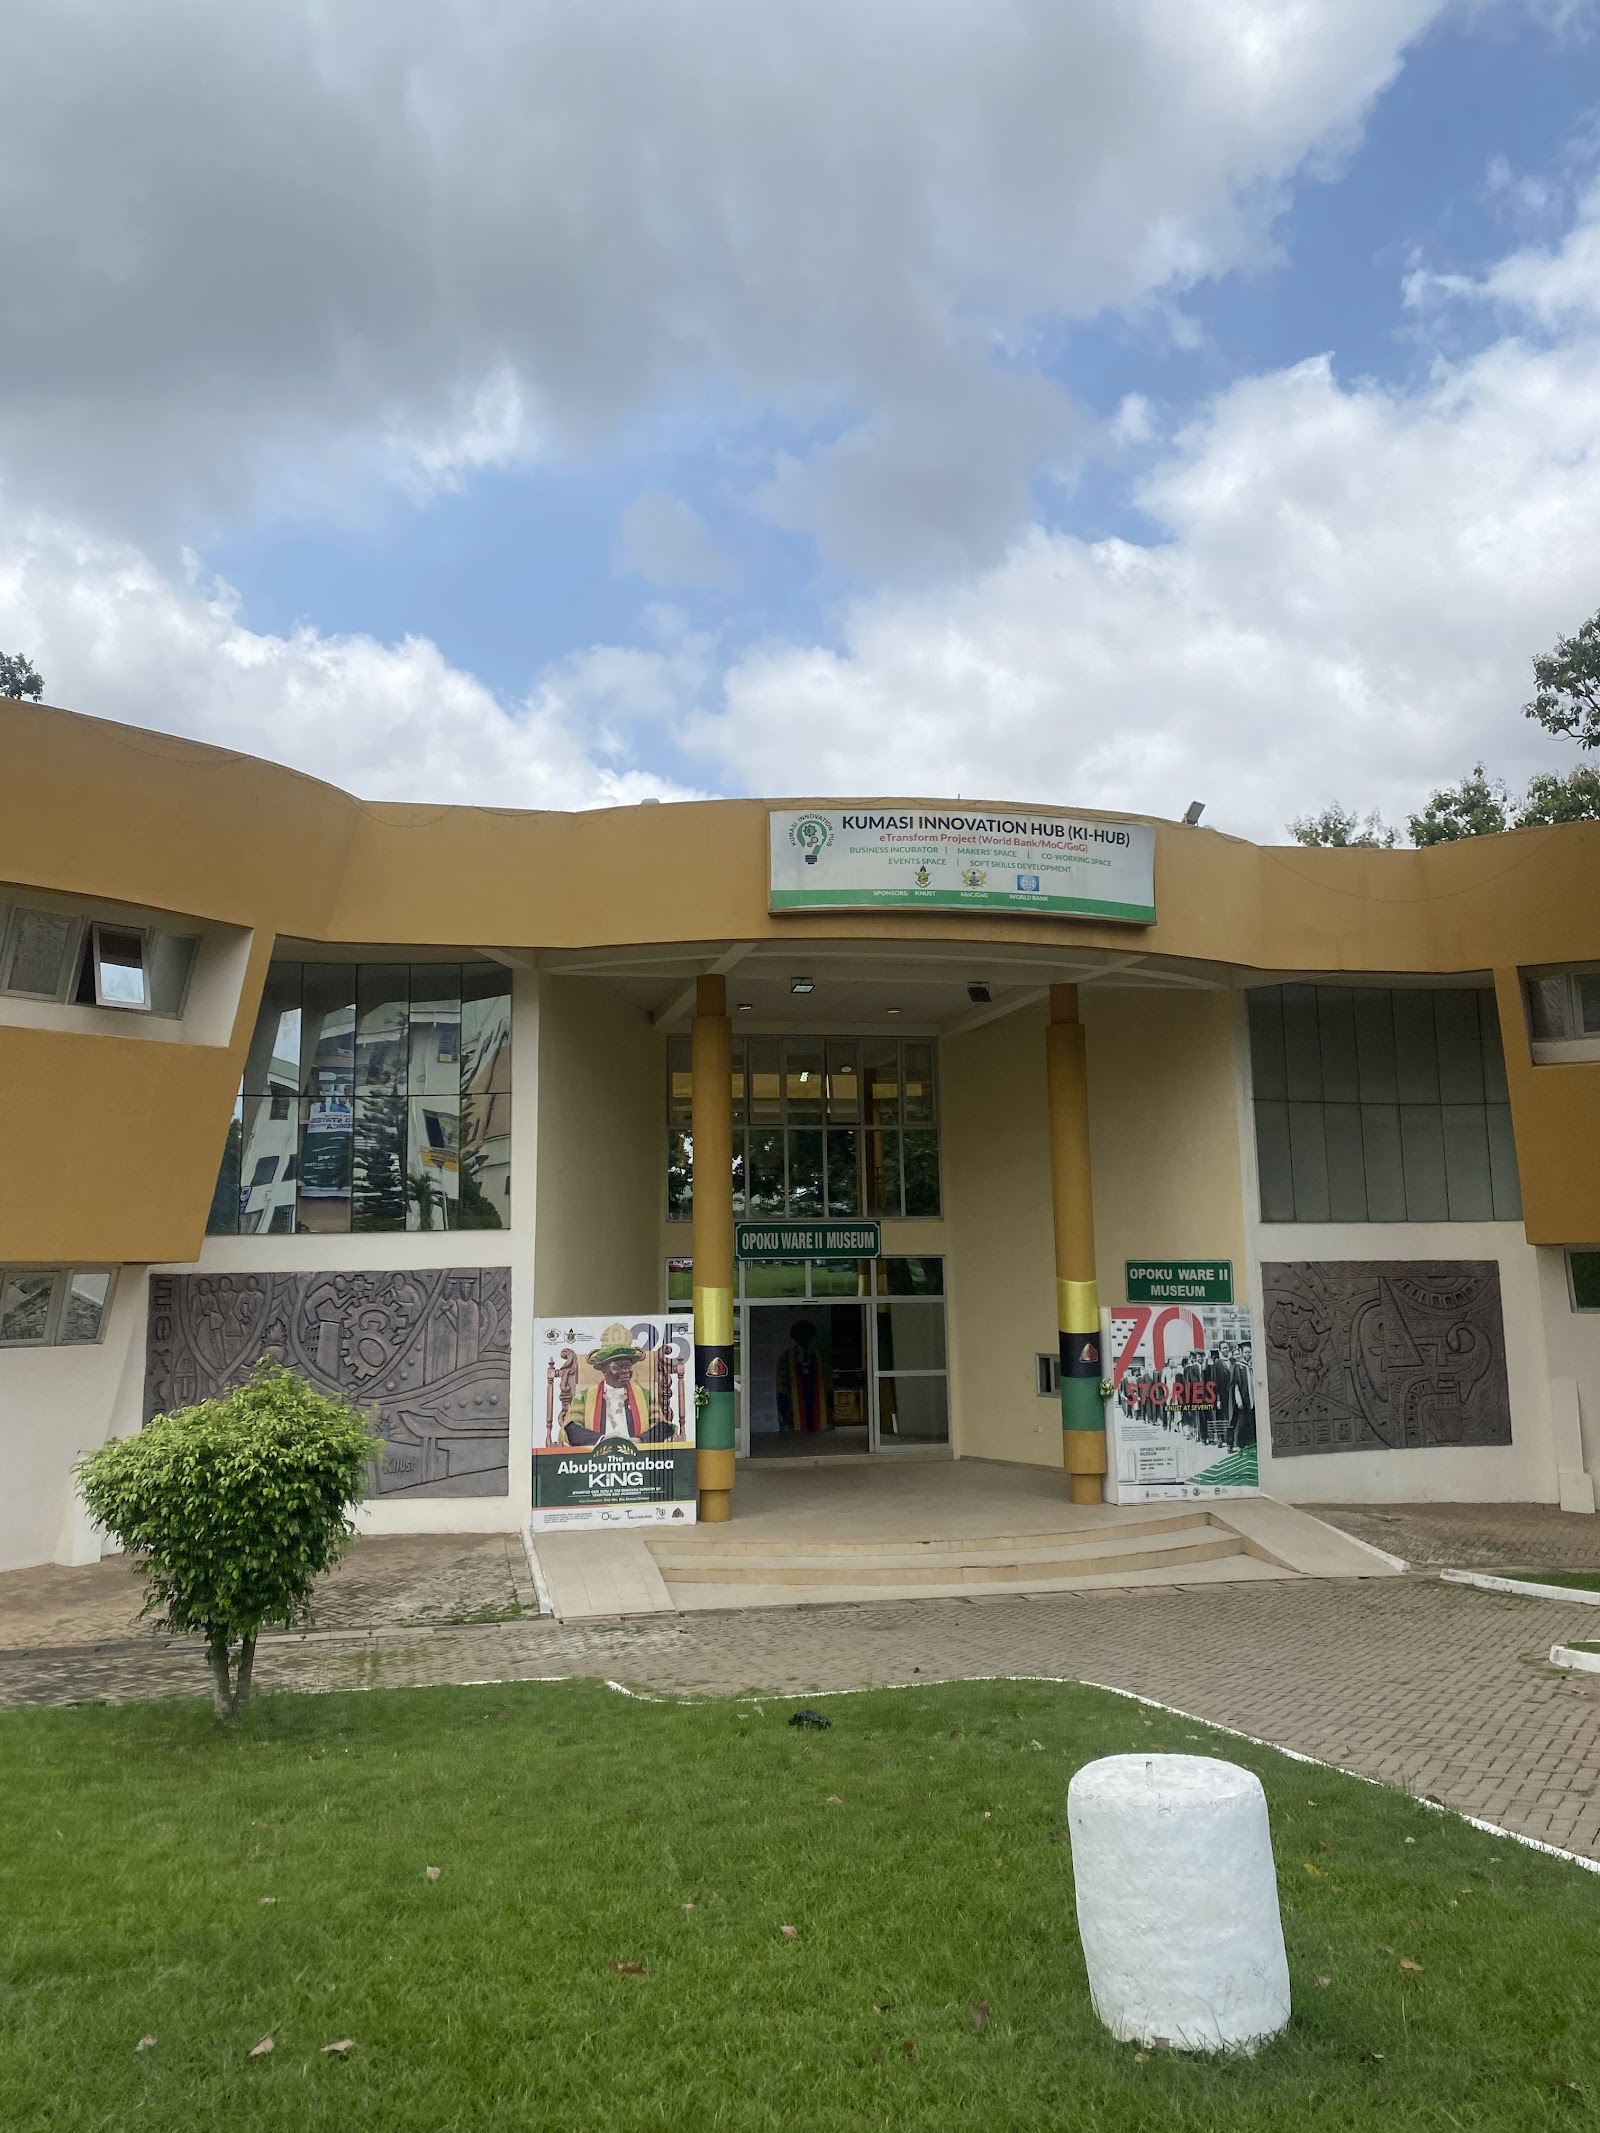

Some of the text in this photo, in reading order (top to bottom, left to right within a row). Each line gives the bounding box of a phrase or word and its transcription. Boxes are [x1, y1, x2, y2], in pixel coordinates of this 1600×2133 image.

[788, 813, 835, 847] KUMASI INNOVATION HUB
[842, 816, 1131, 848] KUMASI INNOVATION HUB (KI-HUB)
[879, 833, 1088, 853] eTransform Project (World Bank/MoC/GoG)
[849, 846, 939, 854] BUSINESS INCUBATOR
[993, 849, 1017, 858] SPACE
[921, 858, 947, 866] SPACE
[969, 860, 1072, 873] SOFT SKILLS DEVELOPMENT
[1041, 853, 1112, 867] CO-WORKING SPACE
[960, 891, 989, 899] MoC/GoG
[1008, 893, 1049, 902] WORLD BANK
[741, 1231, 875, 1250] OPOKU WARE II MUSEUM
[1129, 1268, 1228, 1281] OPOKU WARE II
[1150, 1285, 1206, 1297] MUSEUM
[1111, 1307, 1205, 1388] 70
[1126, 1381, 1217, 1406] STORIES
[1164, 1404, 1182, 1412] KNUST
[607, 1455, 624, 1463] The
[557, 1457, 674, 1475] Abubummabaa
